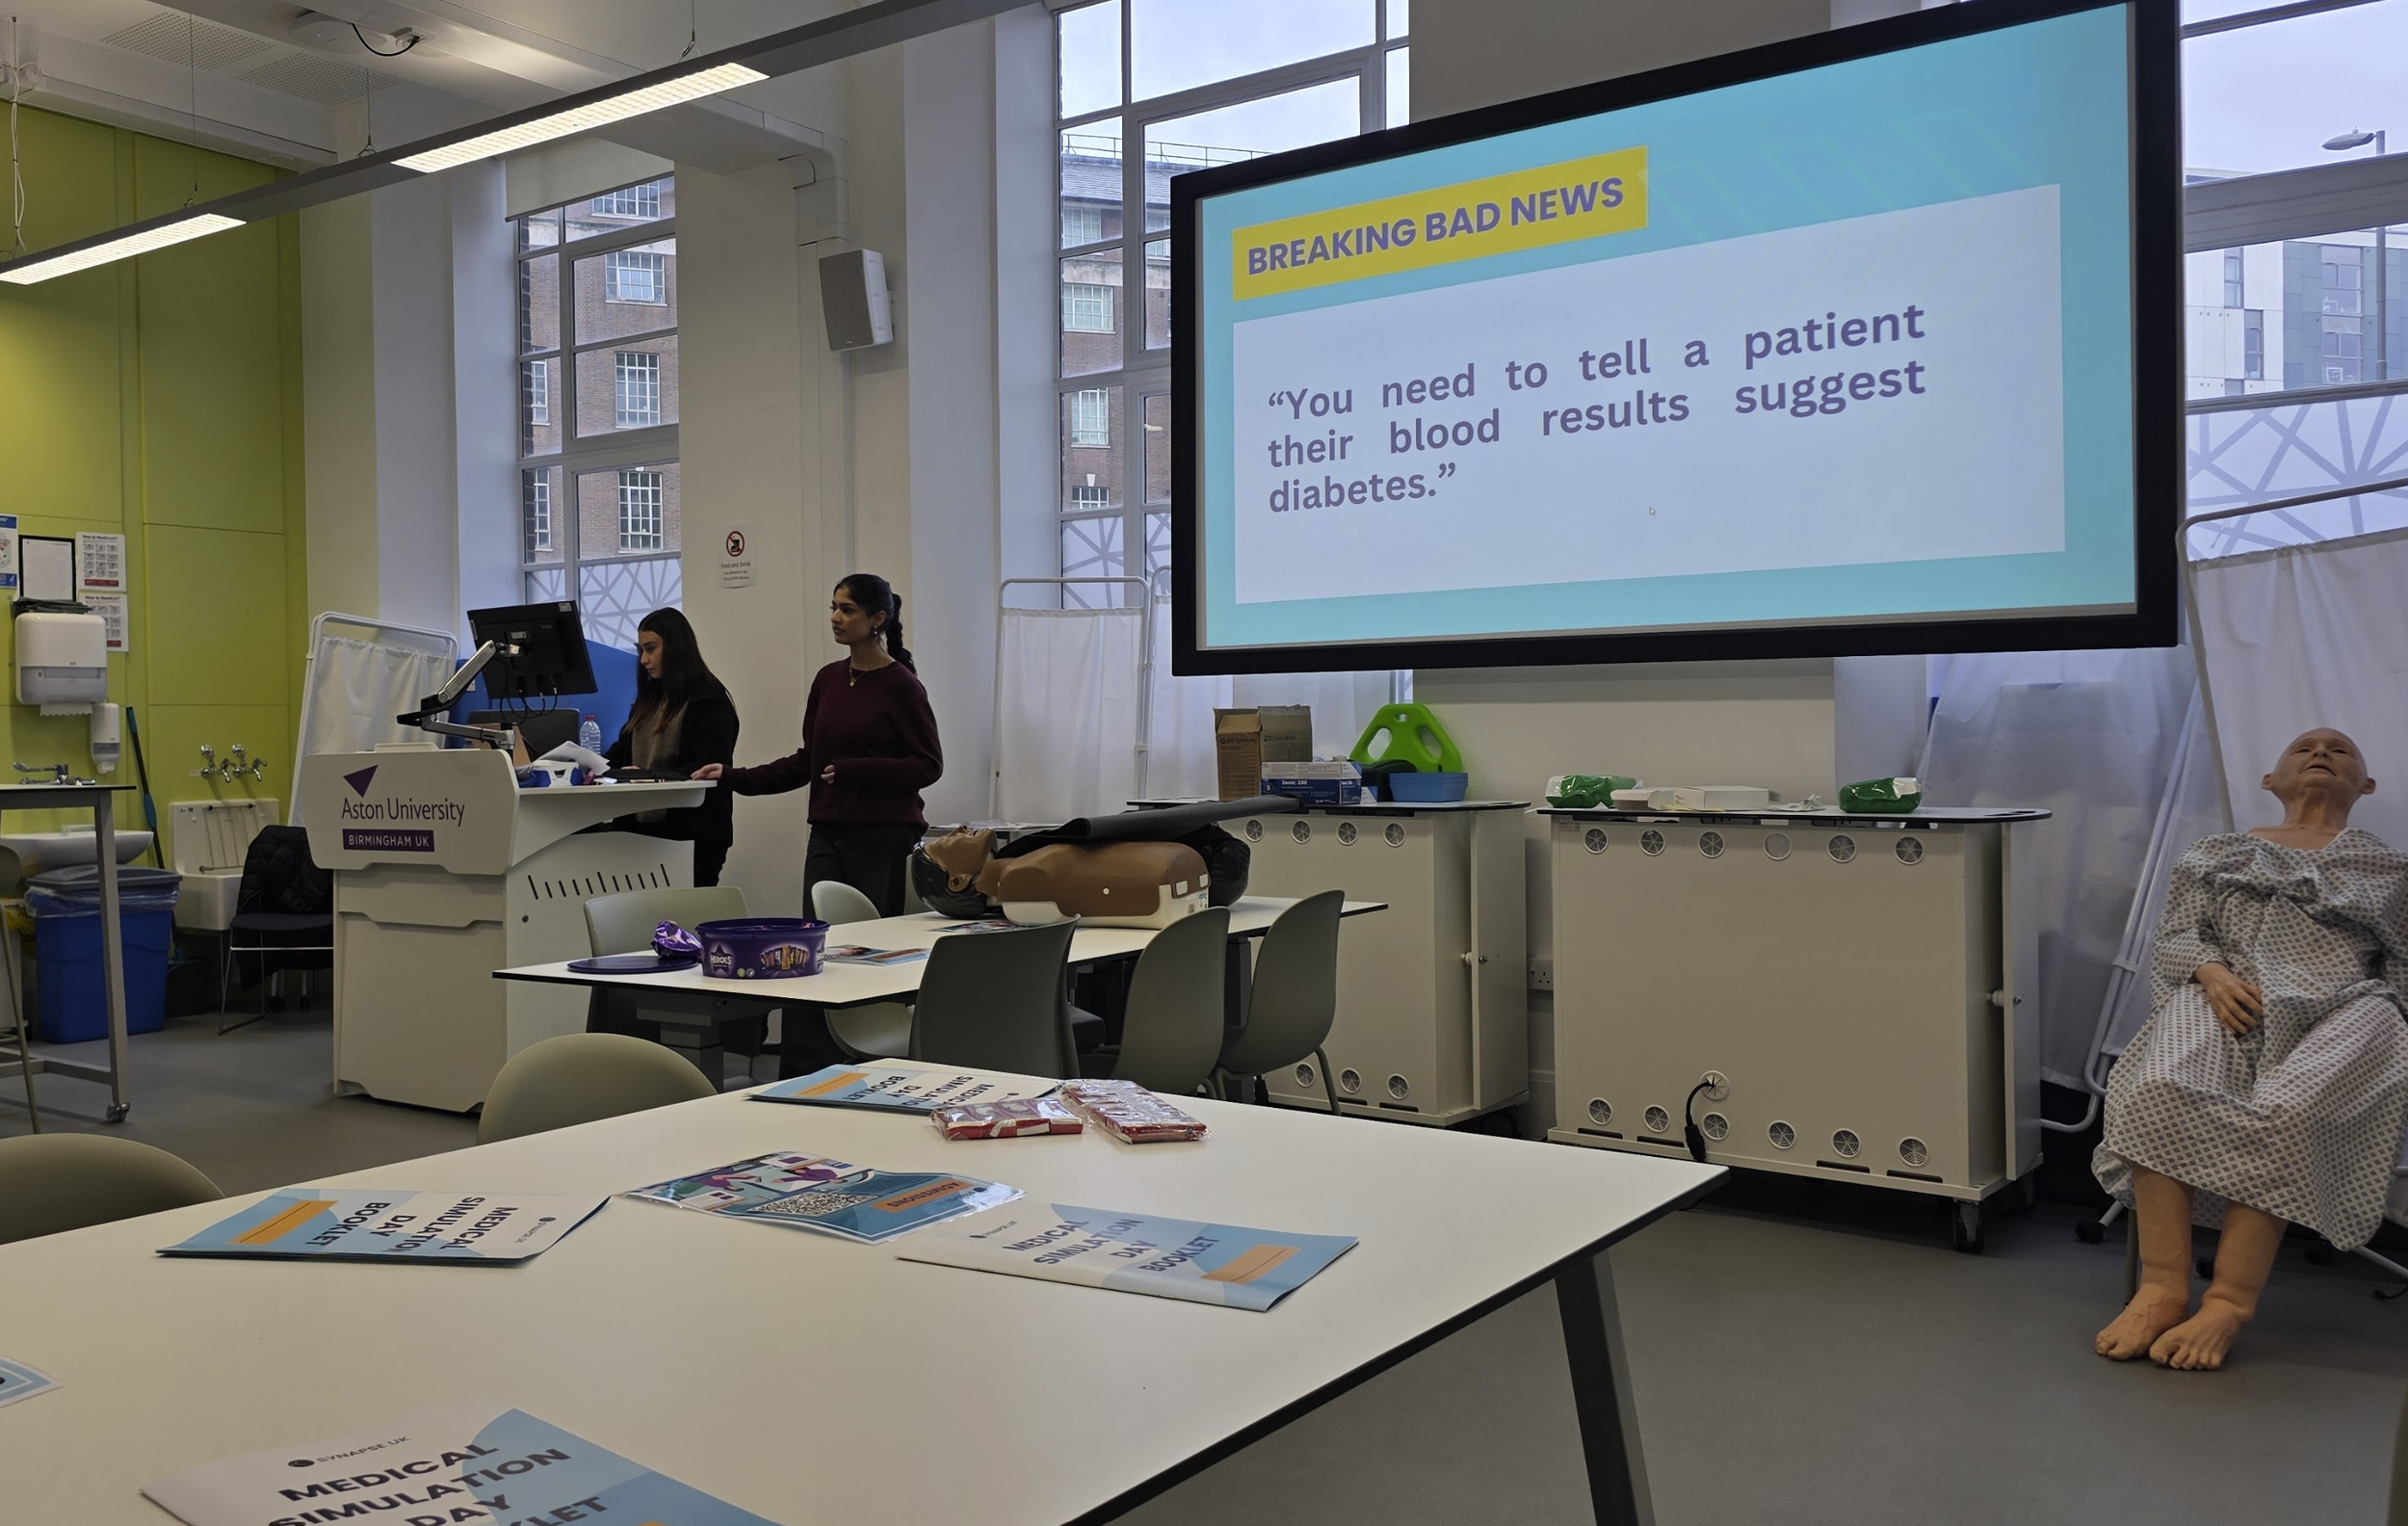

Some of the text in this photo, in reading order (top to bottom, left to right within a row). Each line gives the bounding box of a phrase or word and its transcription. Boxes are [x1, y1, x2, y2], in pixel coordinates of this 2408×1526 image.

[1248, 177, 1624, 275] BREAKING BAD NEWS
[1269, 304, 1925, 420] “You need to tell a patient
[1269, 360, 1926, 467] their blood results suggest
[1269, 462, 1455, 513] diabetes.”
[342, 798, 464, 828] Aston University
[349, 834, 430, 847] BIRMINGHAM UK
[711, 955, 732, 965] HEROES
[842, 1075, 907, 1101] BOOKLET
[886, 1085, 922, 1098] DAY
[901, 1075, 974, 1107] SIMULATIO
[886, 1181, 961, 1208] ADMISSIONS
[304, 1202, 392, 1246] BOOKLET
[370, 1215, 418, 1237] DAY
[439, 1207, 519, 1250] MEDICAL
[1002, 1220, 1089, 1250] MEDICAL
[1034, 1218, 1144, 1265] SIMULATION
[1110, 1239, 1159, 1259] DAY
[1138, 1235, 1220, 1272] BOOKLET
[316, 1436, 410, 1462] SYNAPSE UK
[277, 1443, 500, 1502] MEDICAL
[405, 1493, 512, 1526] DAY
